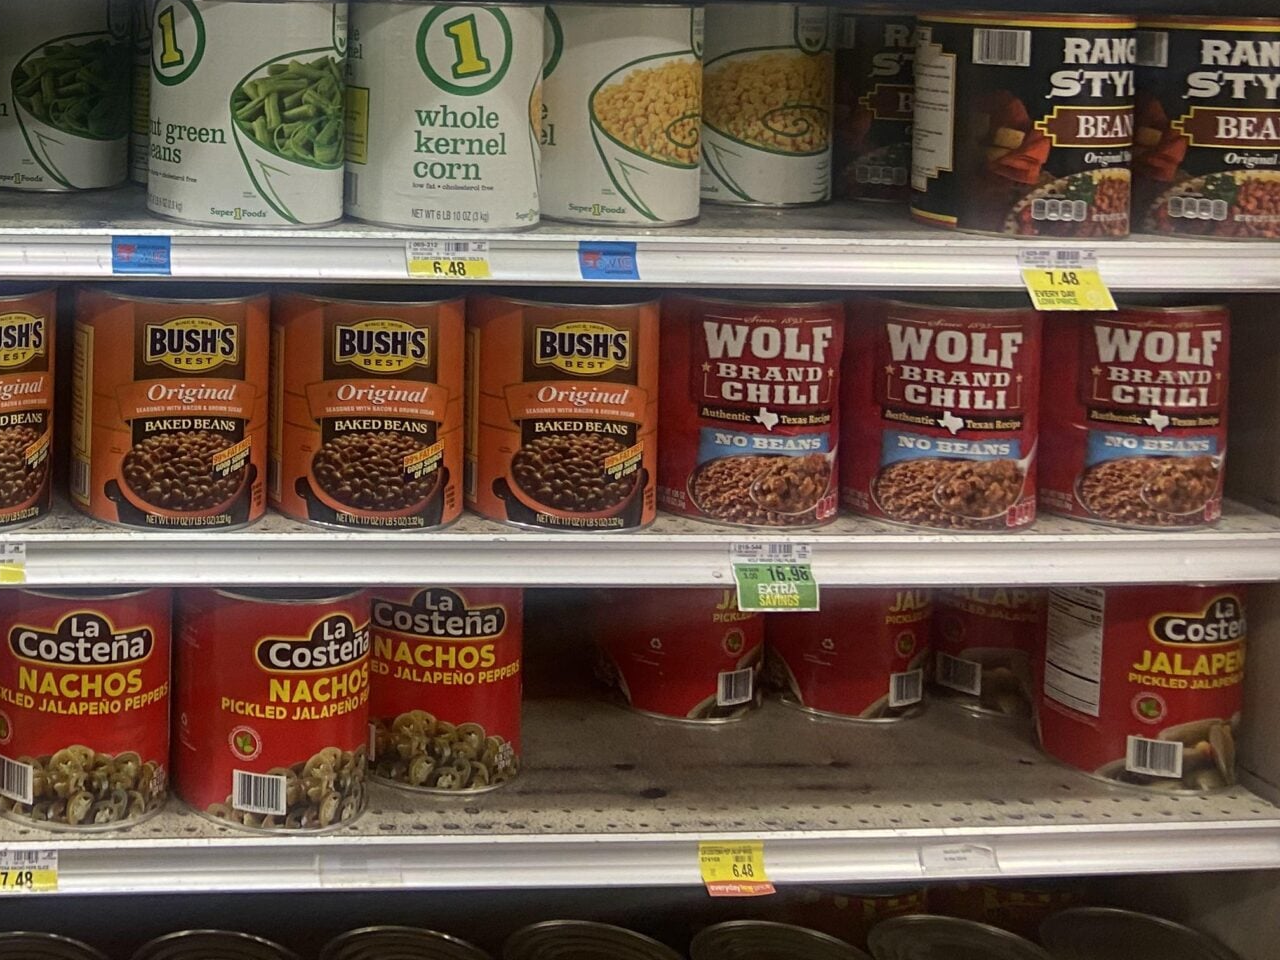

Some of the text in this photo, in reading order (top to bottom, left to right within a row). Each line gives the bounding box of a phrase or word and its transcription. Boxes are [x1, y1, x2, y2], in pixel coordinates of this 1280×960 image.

[414, 105, 499, 130] whole
[165, 123, 227, 145] green
[414, 130, 507, 156] kernel
[1084, 151, 1121, 167] Original
[413, 161, 482, 181] corn
[433, 261, 466, 277] 6.48
[1045, 272, 1079, 286] 7.48
[339, 329, 426, 358] BUSH'S
[703, 320, 833, 363] WOLF
[887, 324, 1023, 369] WOLF
[1093, 325, 1222, 367] WOLF
[716, 362, 823, 382] BRAND
[900, 365, 1011, 388] BRAND
[722, 381, 819, 405] CHILI
[904, 386, 1006, 410] CHILI
[11, 413, 43, 429] BEANS
[702, 408, 751, 421] Authentic
[780, 414, 807, 425] Texas
[715, 433, 821, 450] NO BEANS
[767, 565, 810, 582] 16.98
[71, 617, 99, 638] La
[374, 602, 500, 637] Costeña
[19, 631, 145, 664] Costeña
[20, 667, 142, 698] NACHOS
[393, 658, 520, 686] JALAPEÑO PEPPERS
[1128, 672, 1188, 690] PICKLED
[38, 697, 121, 716] JALAPEÑO
[125, 680, 168, 712] PEPPERS
[221, 696, 358, 721] PICKLED JALAPEÑO
[0, 871, 34, 889] 7.48
